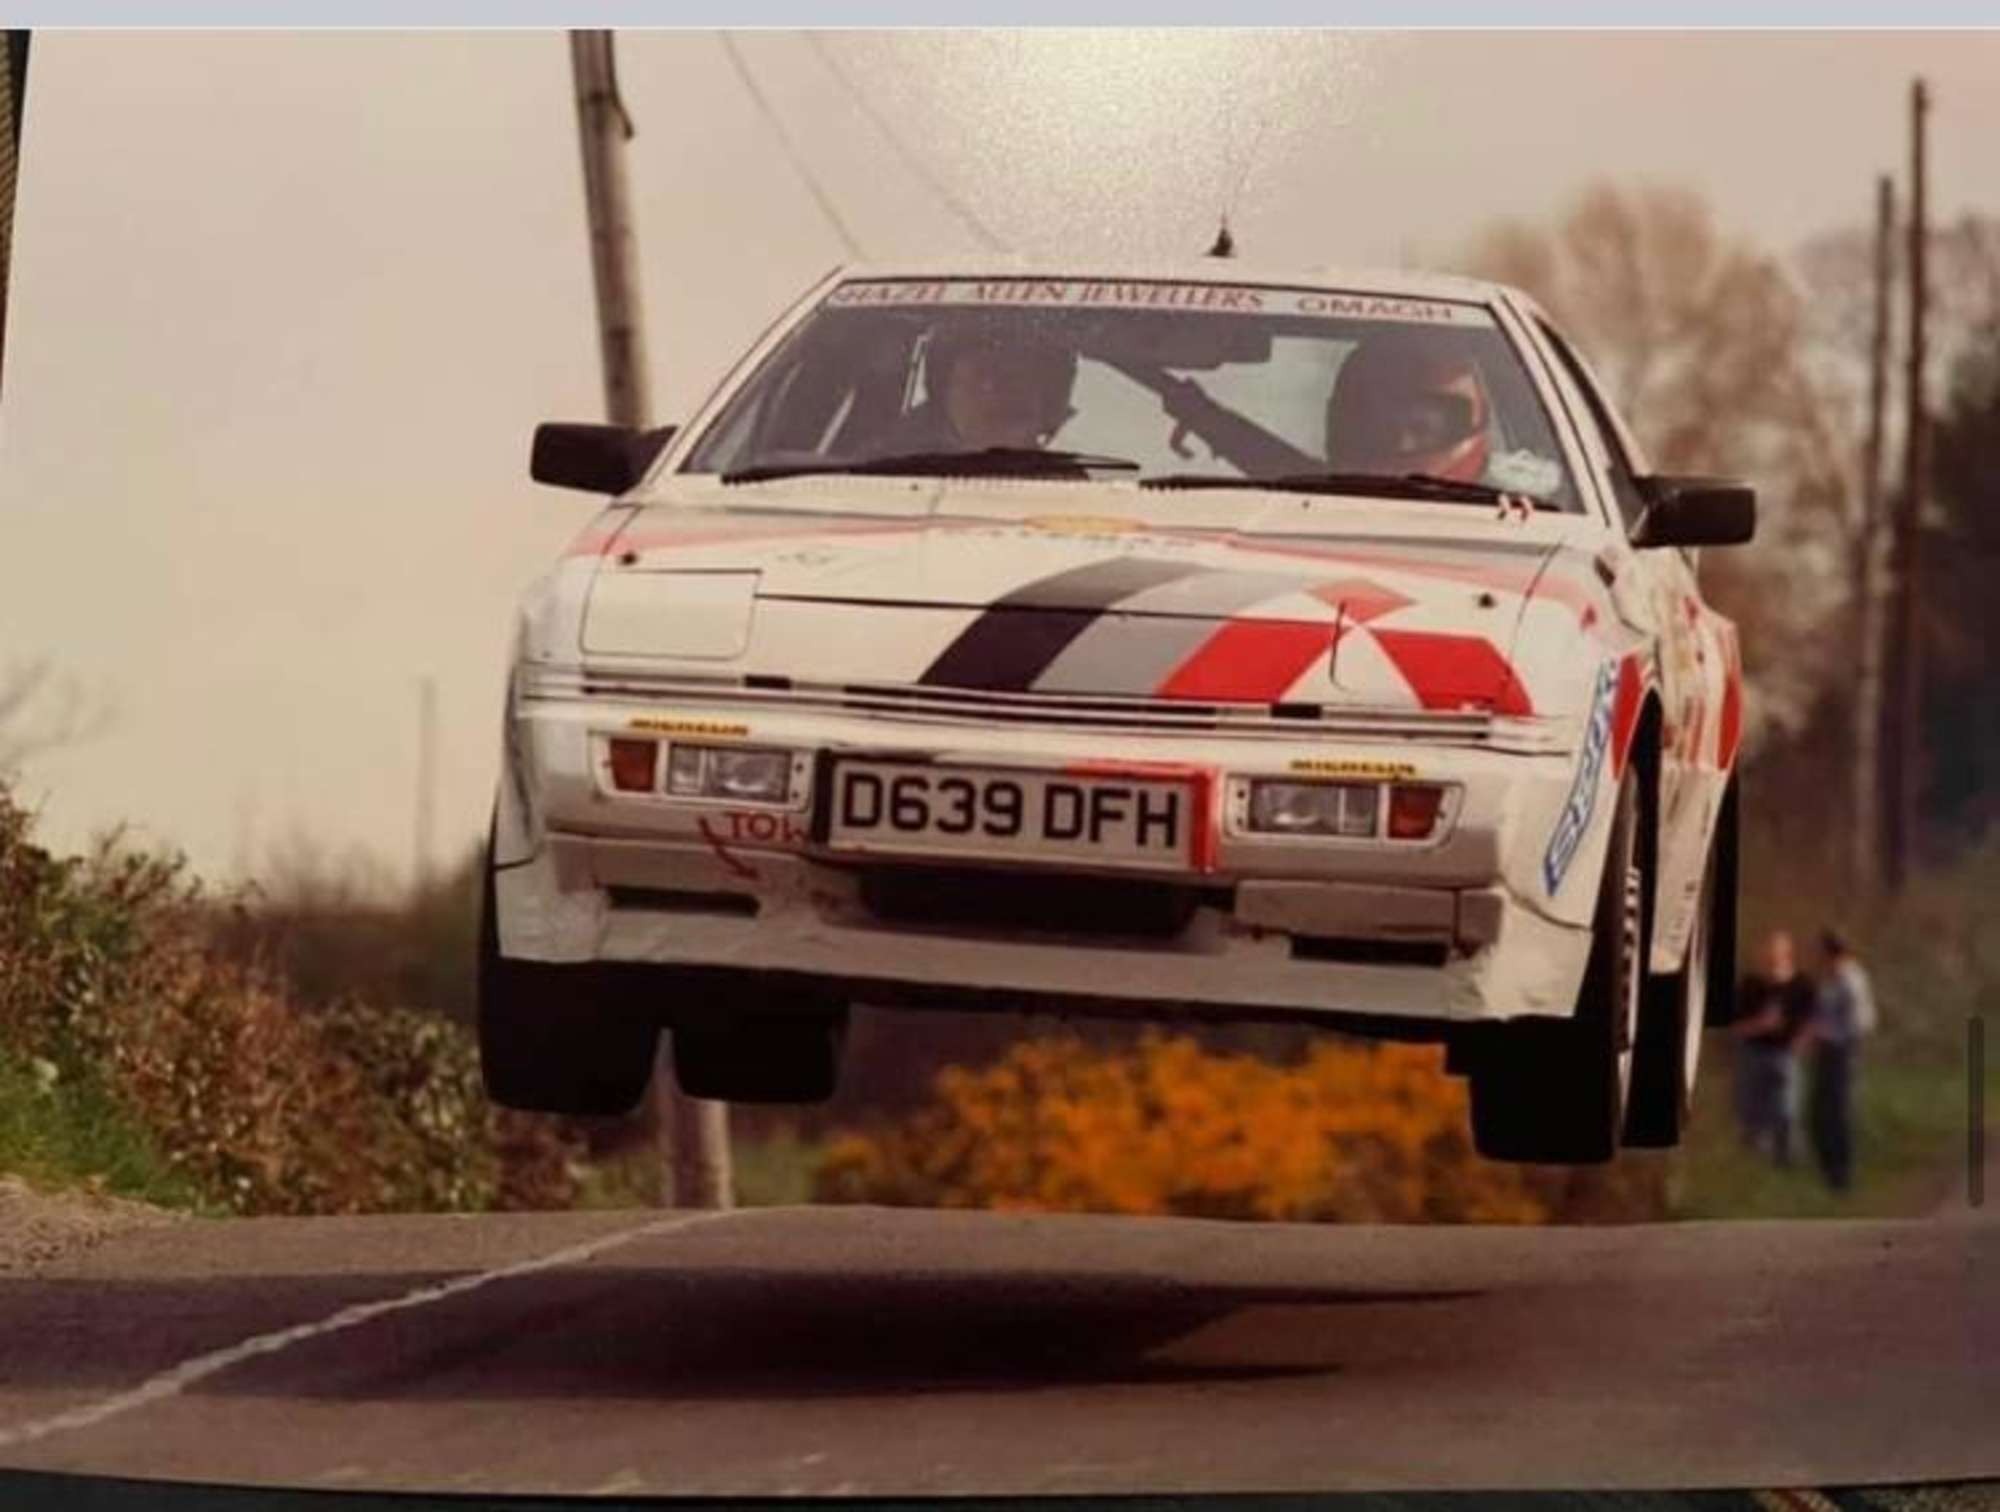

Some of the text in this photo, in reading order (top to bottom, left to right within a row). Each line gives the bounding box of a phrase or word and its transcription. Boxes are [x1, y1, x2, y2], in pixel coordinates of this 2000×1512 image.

[1296, 295, 1454, 320] OMAGH
[841, 771, 1179, 849] D639 DFH
